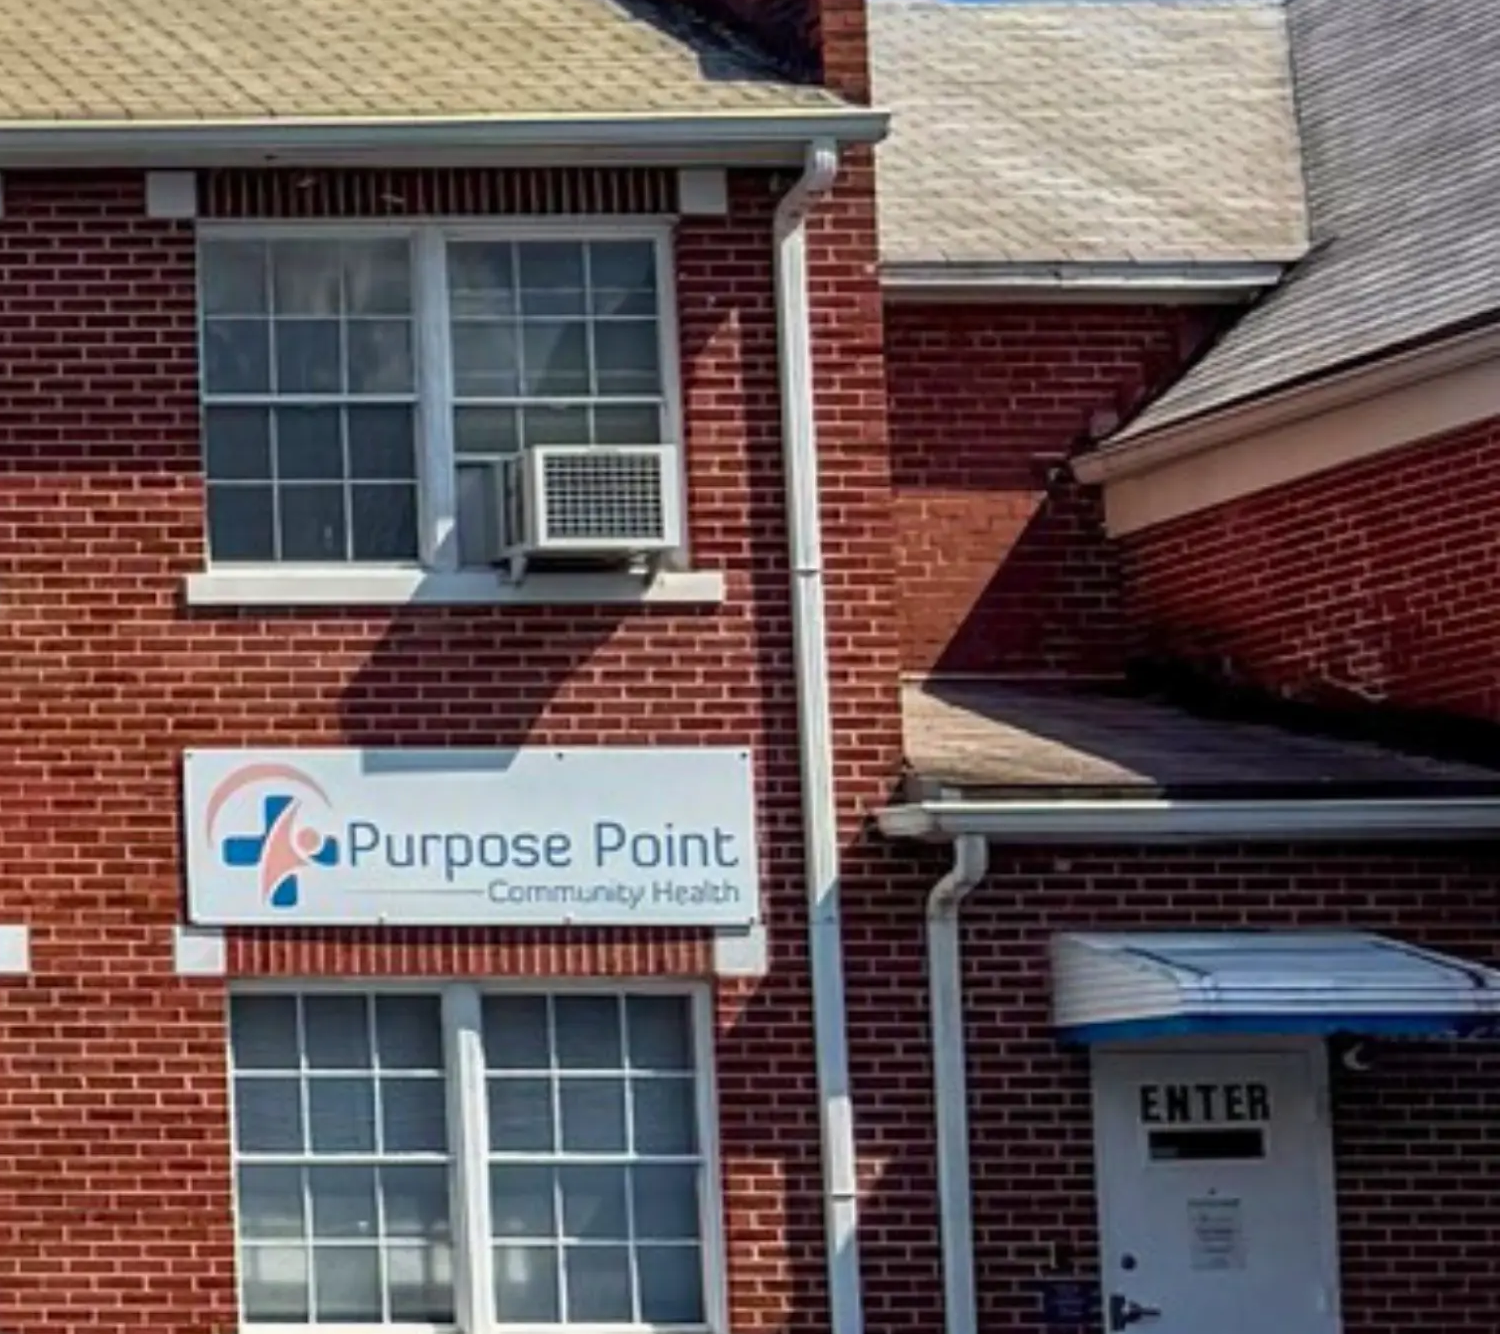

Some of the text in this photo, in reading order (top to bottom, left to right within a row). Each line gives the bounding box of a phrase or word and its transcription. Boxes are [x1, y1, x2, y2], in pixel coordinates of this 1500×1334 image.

[348, 821, 740, 882] Purpose Point
[487, 879, 740, 909] Community Health
[1139, 1083, 1271, 1123] ENTER
